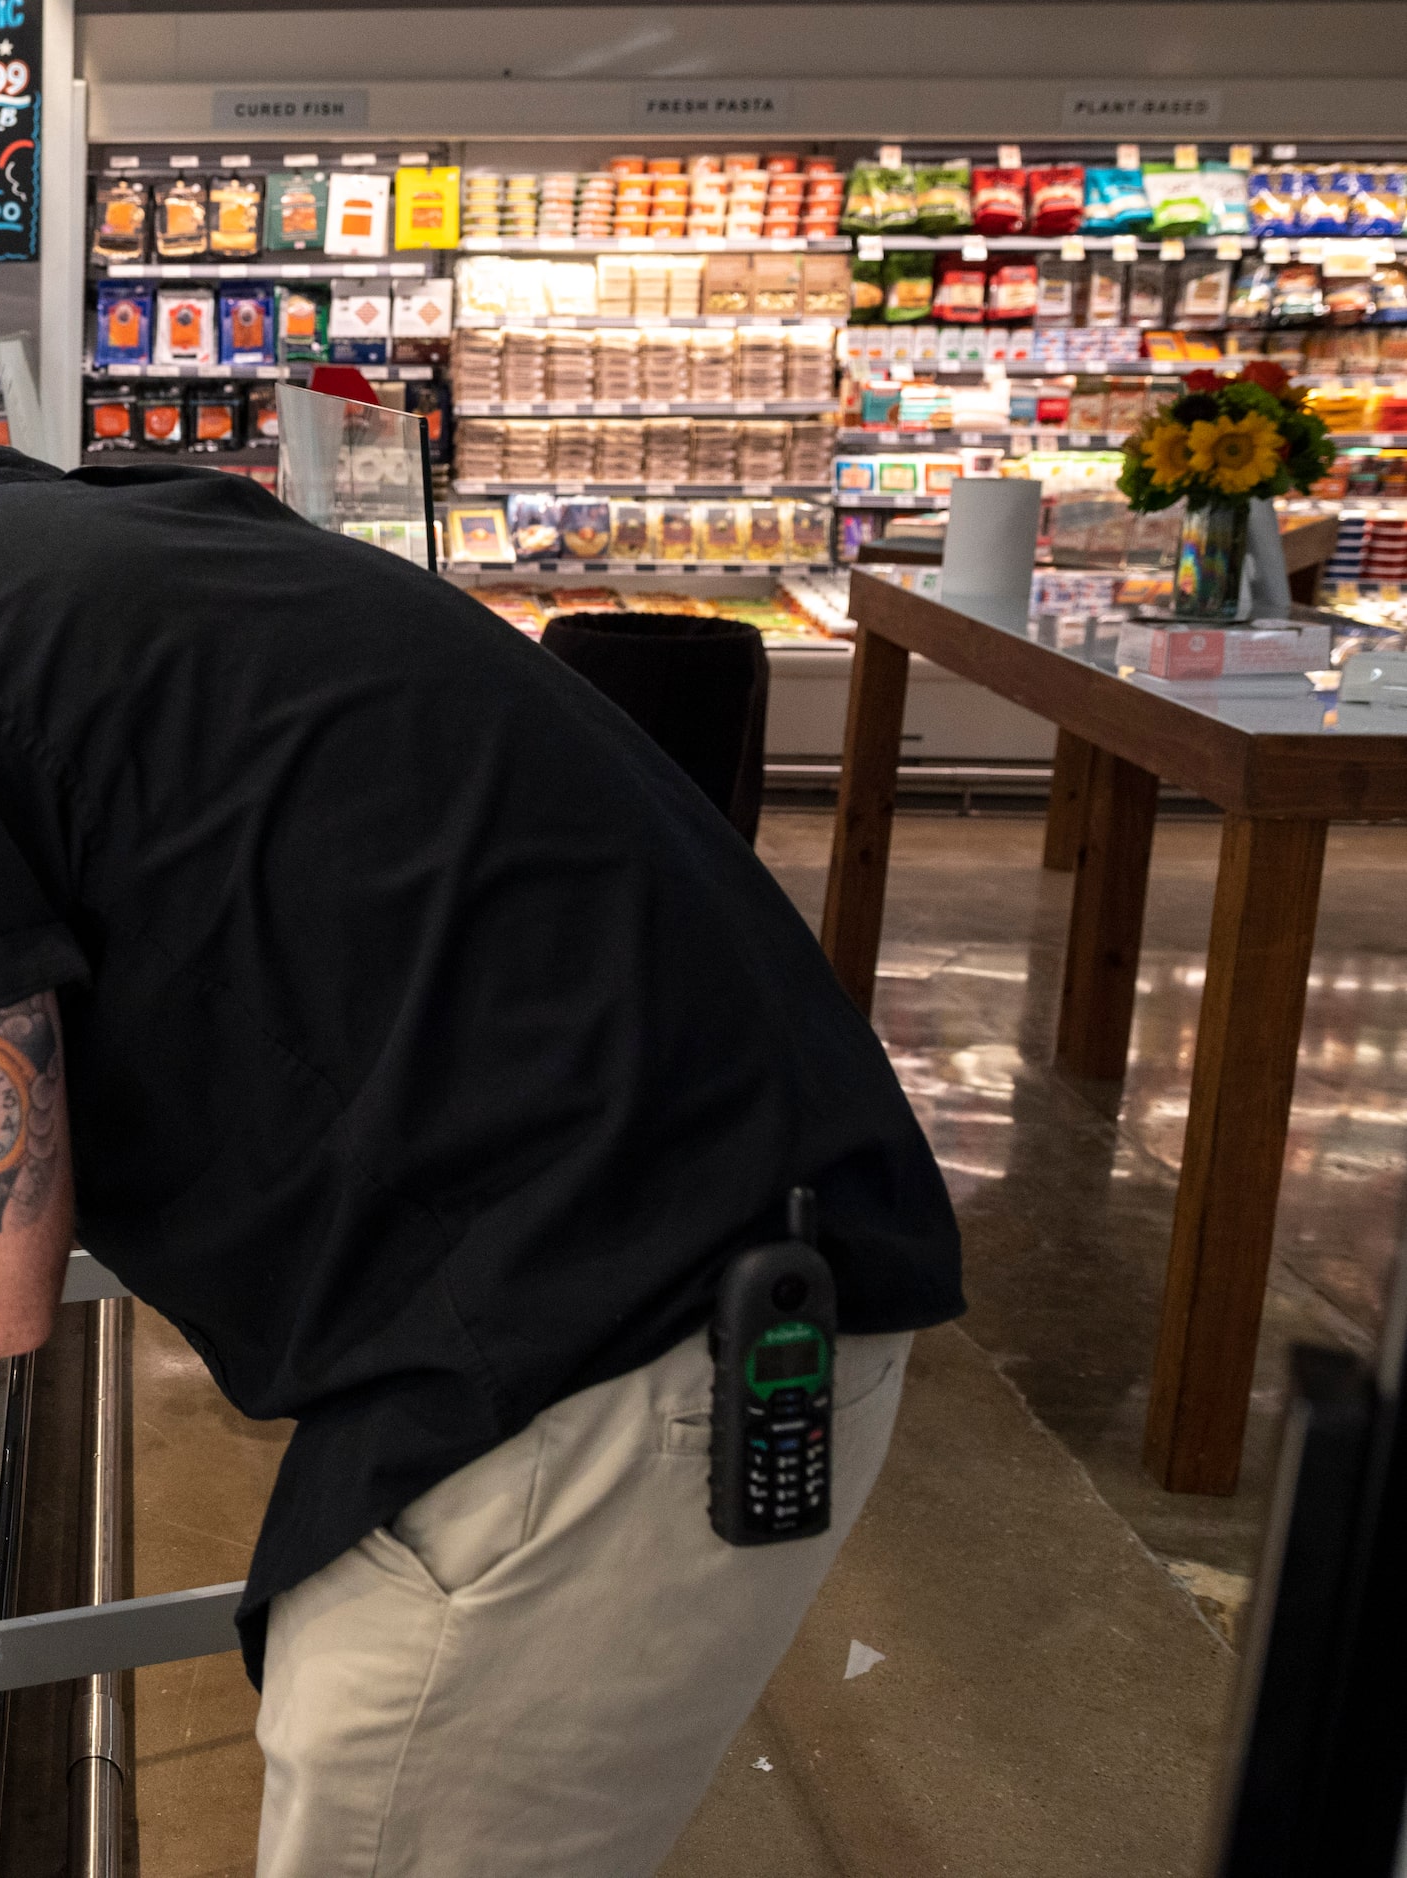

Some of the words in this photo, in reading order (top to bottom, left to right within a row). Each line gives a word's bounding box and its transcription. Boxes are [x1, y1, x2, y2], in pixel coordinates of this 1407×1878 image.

[234, 103, 296, 117] CURED
[303, 102, 344, 116] FISH
[647, 98, 709, 113] FRESH
[715, 98, 775, 112] PASTA
[2, 1089, 17, 1110] 3
[1, 1115, 15, 1134] 4
